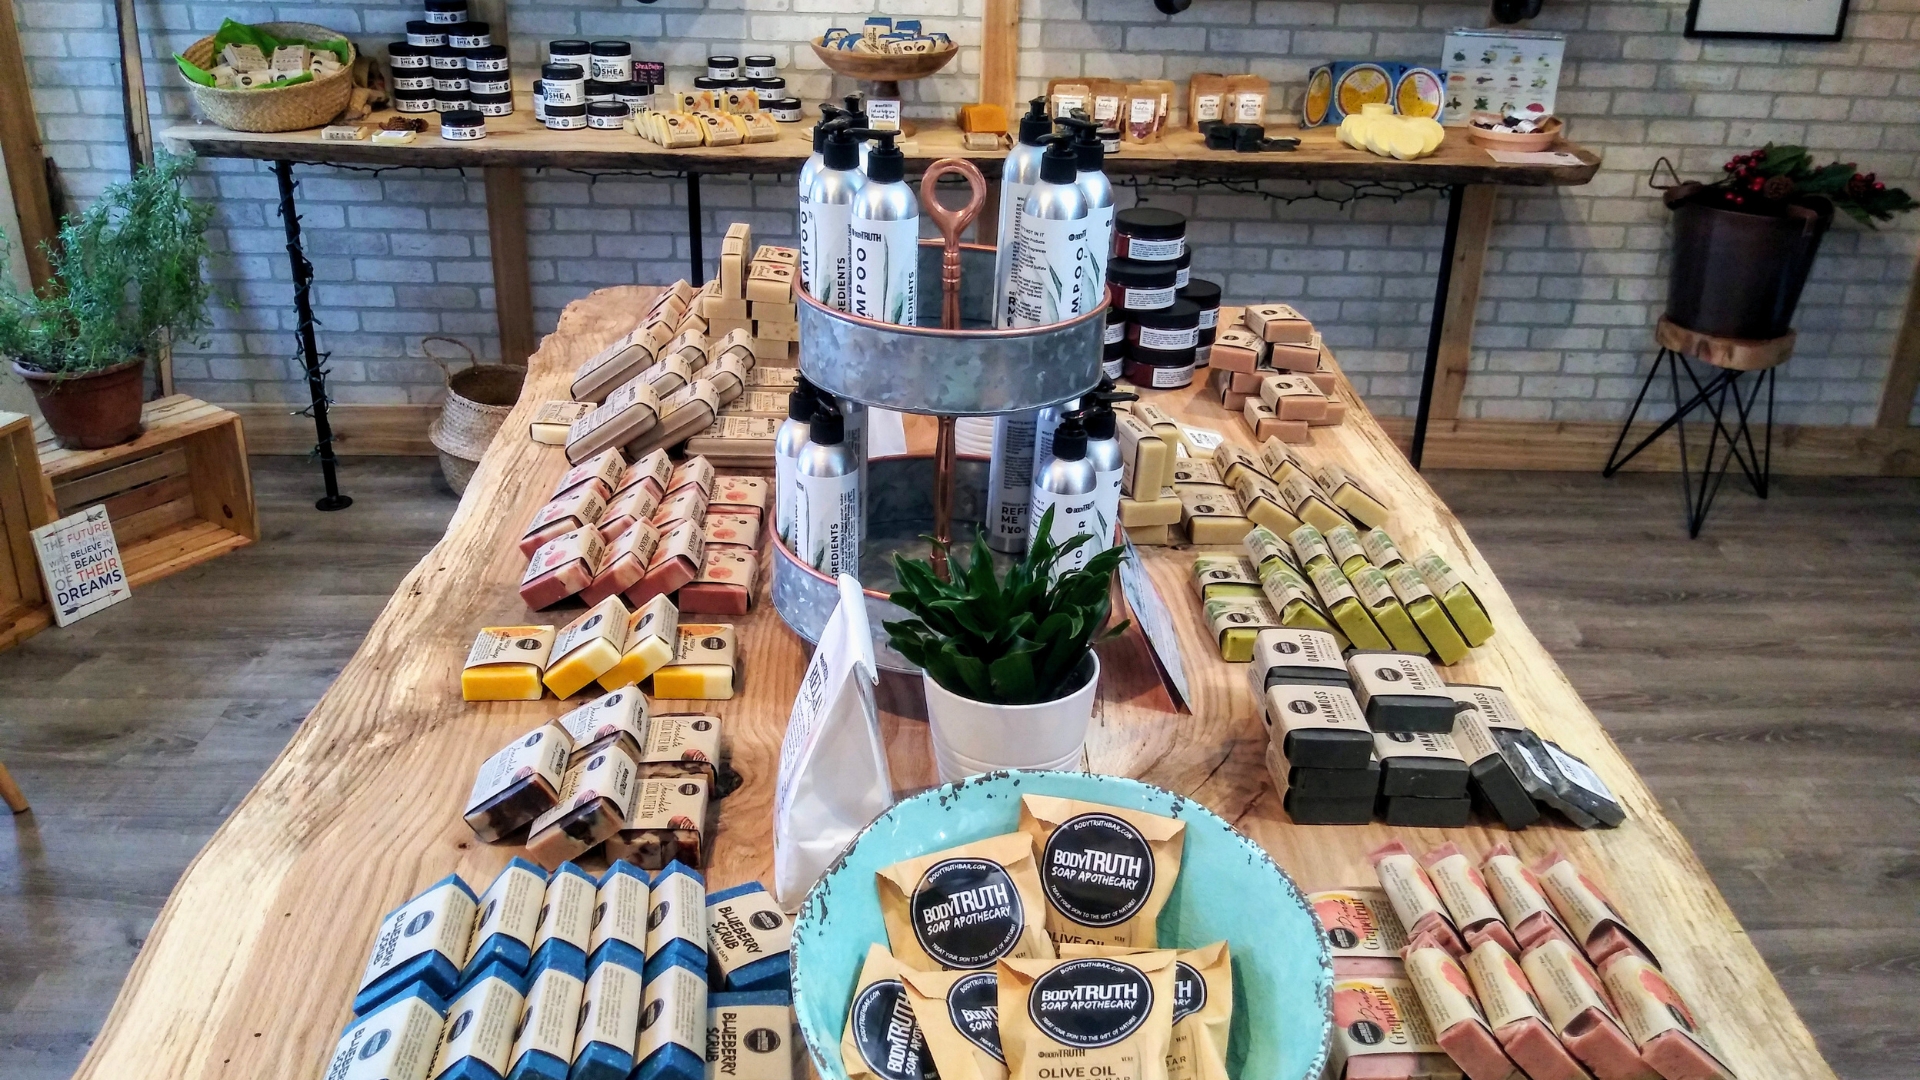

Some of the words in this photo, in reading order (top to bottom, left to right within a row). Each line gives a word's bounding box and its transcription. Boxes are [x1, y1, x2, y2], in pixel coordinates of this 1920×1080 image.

[548, 92, 571, 100] SHEA
[1001, 516, 1018, 524] ME
[44, 536, 65, 553] THE
[67, 520, 109, 544] FUTURE
[49, 555, 69, 568] WHO
[70, 541, 102, 560] BELIEVE
[51, 565, 73, 579] THE
[74, 546, 114, 570] BEAUTY
[55, 575, 73, 591] OF
[76, 557, 118, 582] THEIR
[57, 569, 122, 606] DREAMS
[1299, 634, 1320, 663] OAKMOSS
[1398, 659, 1426, 691] OAKMOSS
[1314, 690, 1339, 724] OAKMOSS
[1473, 692, 1502, 723] OAKMOSS
[1073, 819, 1133, 840] BODYTRUTHBAR.COM
[927, 863, 987, 884] BODYTRUTHBAR.COM
[1051, 866, 1077, 880] SOAP
[1077, 871, 1138, 891] APOTHECARY
[1053, 848, 1142, 878] BODYTRUTH
[922, 883, 1010, 924] BODYTRUTH
[1051, 884, 1062, 899] TREAT
[1060, 898, 1072, 910] YOUR
[1071, 907, 1082, 916] SKIN
[1111, 910, 1118, 918] OF
[1118, 898, 1137, 914] NATURE!
[1333, 899, 1356, 928] Pink
[711, 921, 740, 950] SCRUB
[718, 906, 763, 954] BLUEBERRY
[926, 919, 951, 936] SOAP
[953, 905, 1011, 929] APOTHECARY
[1351, 898, 1380, 951] Grapefruit
[373, 932, 391, 966] SCRUB
[380, 911, 407, 969] BLUEBERRY
[931, 942, 945, 955] TREAT
[945, 951, 958, 961] YOUR
[979, 953, 988, 961] THE
[988, 947, 998, 957] GIFT
[998, 942, 1004, 950] OF
[1003, 923, 1017, 944] NATURE!
[1060, 962, 1125, 975] BODYTRUTHBAR.COM
[1040, 1001, 1068, 1011] SOAP
[1070, 999, 1137, 1010] APOTHECARY
[1041, 982, 1138, 1001] BODYTRUTH
[1353, 986, 1382, 1022] Pink
[969, 1022, 992, 1032] SOAP
[1042, 1016, 1054, 1029] TREAT
[1053, 1026, 1065, 1036] YOUR
[1066, 1032, 1079, 1040] SKIN
[1119, 1015, 1138, 1032] NATURE!
[1370, 985, 1408, 1046] Grapefruit
[705, 1027, 719, 1063] SCRUB
[720, 1012, 737, 1076] BLUEBERRY
[1044, 1048, 1086, 1058] BODYTRUTH
[905, 1049, 920, 1077] SOAP
[1038, 1067, 1085, 1079] OLIVE
[1090, 1066, 1116, 1078] OIL
